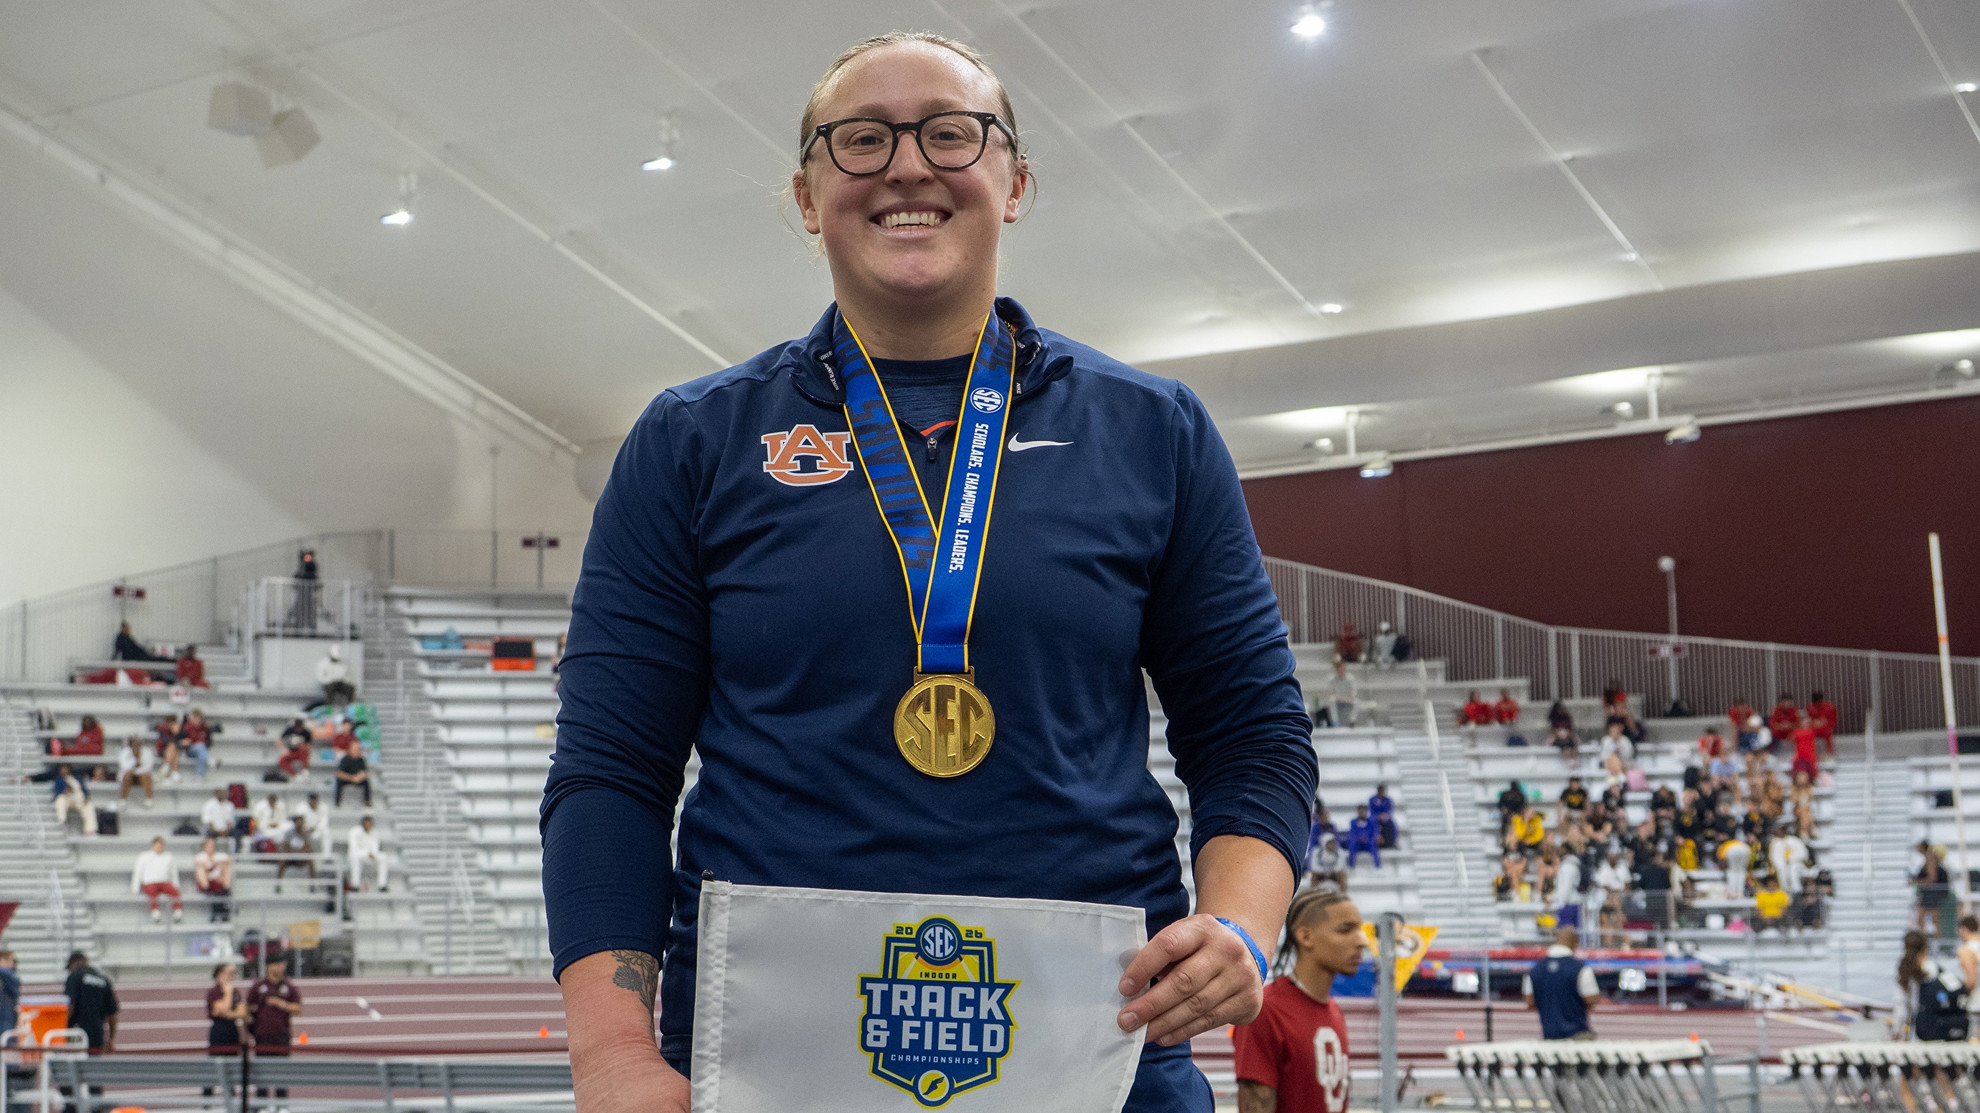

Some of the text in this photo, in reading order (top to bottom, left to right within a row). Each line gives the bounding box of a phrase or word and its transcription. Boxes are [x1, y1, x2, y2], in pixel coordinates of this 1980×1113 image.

[973, 389, 1002, 411] SEC
[949, 423, 989, 574] SCHOLARS. CHAMPIONS. LEADERS.
[903, 684, 985, 768] SEC
[895, 926, 914, 935] 20
[923, 926, 954, 958] SEC
[965, 929, 984, 939] 26
[920, 971, 957, 980] INDOOR
[866, 982, 1006, 1020] TRACK
[866, 1018, 1005, 1053] & FIELD
[891, 1054, 979, 1065] CHAMPIONSHIPS
